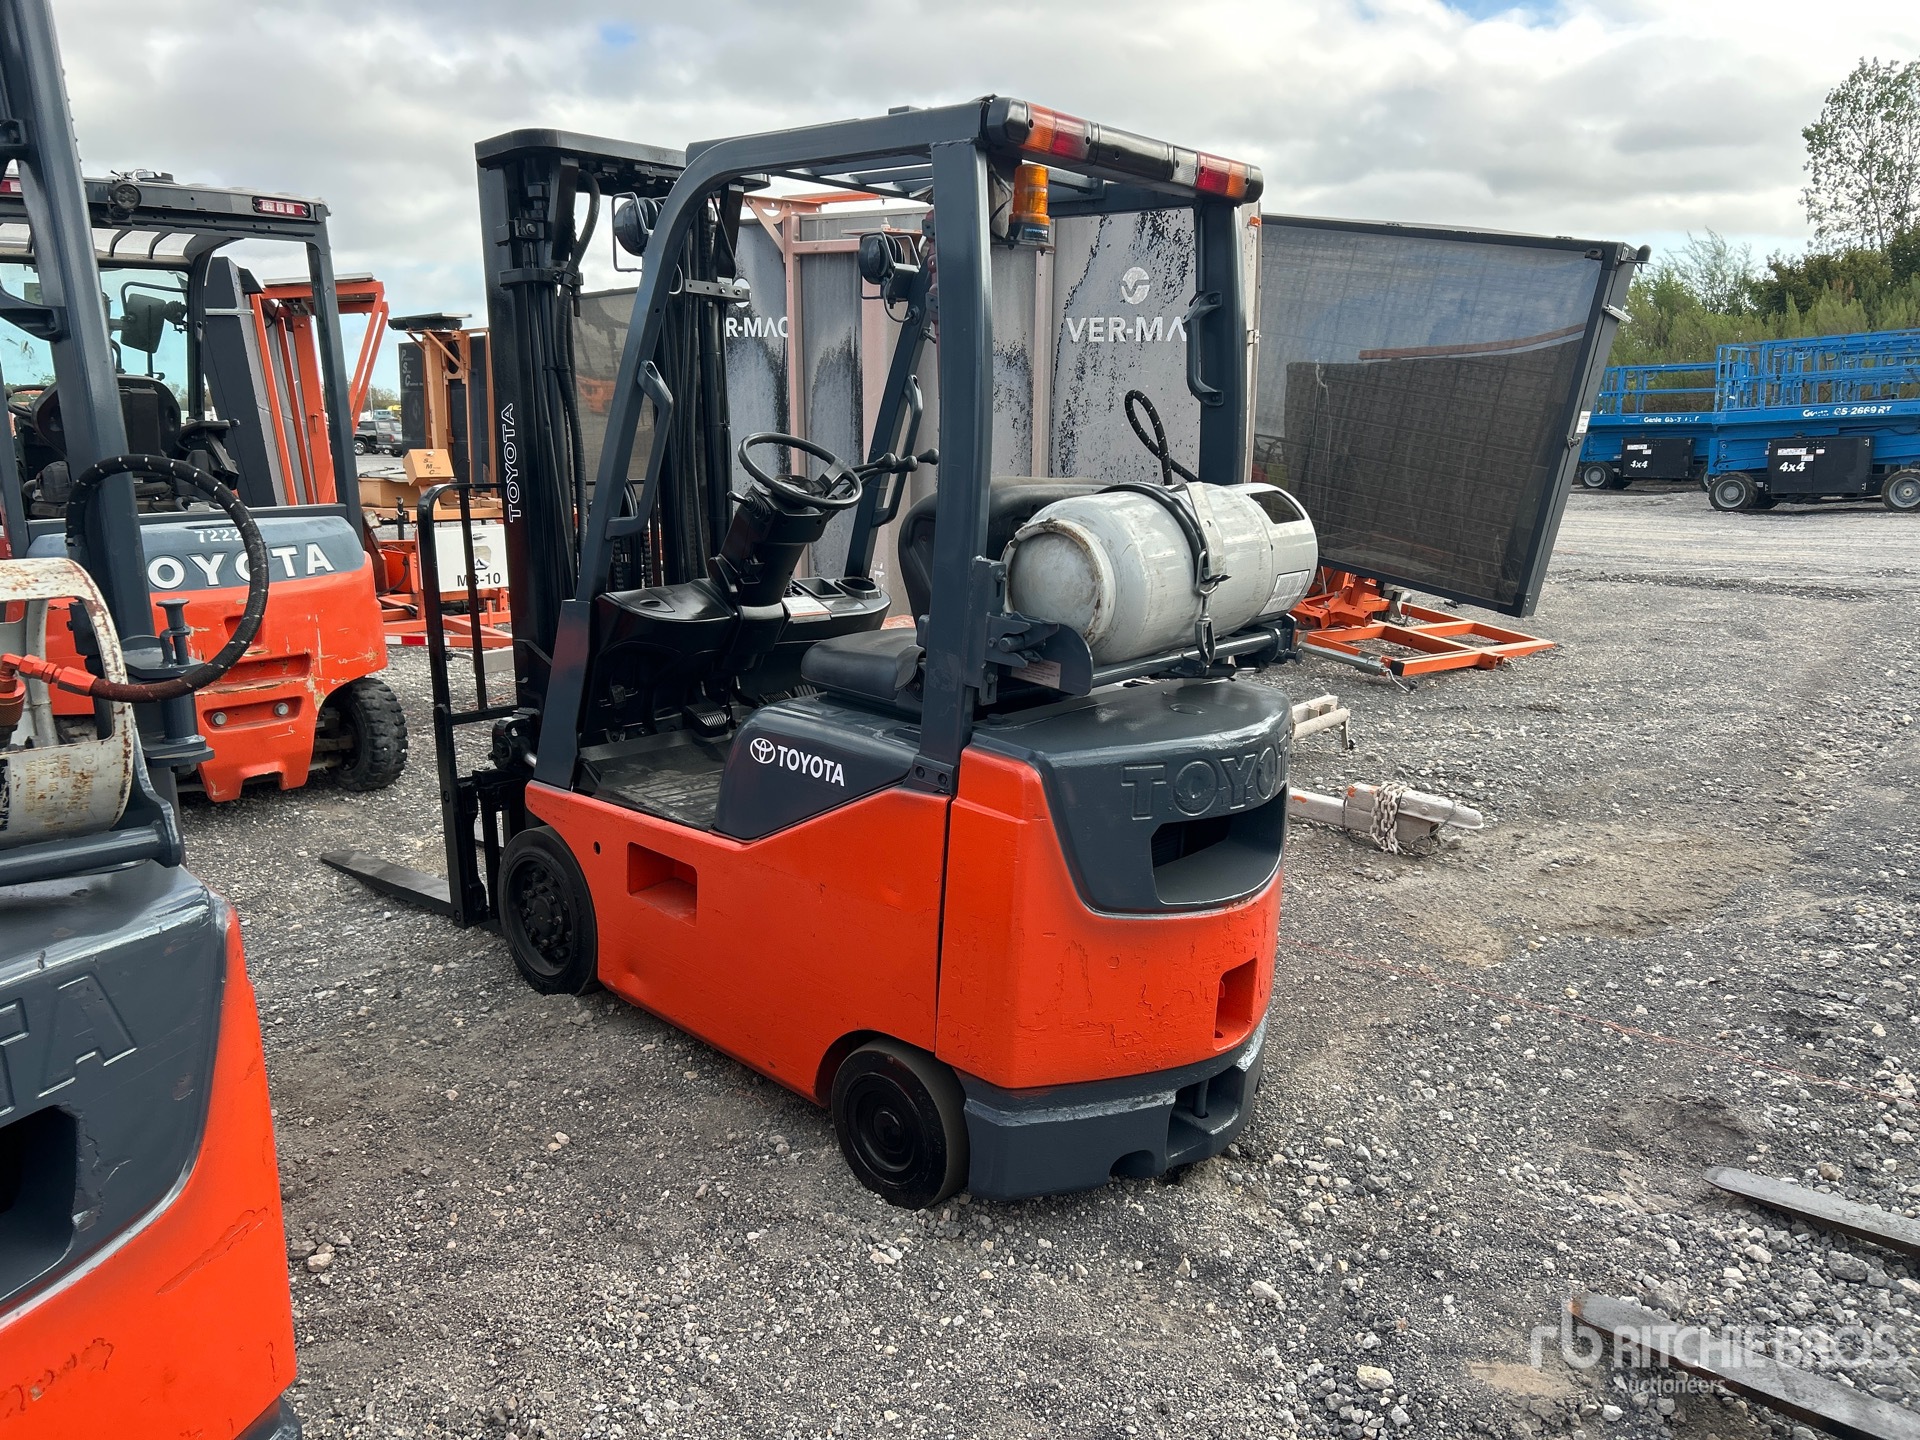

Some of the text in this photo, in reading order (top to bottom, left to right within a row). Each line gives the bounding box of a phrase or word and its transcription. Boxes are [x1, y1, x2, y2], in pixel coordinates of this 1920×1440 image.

[1066, 316, 1188, 342] VER-MA
[501, 403, 521, 522] TOYOTA
[1779, 462, 1806, 472] 4x4
[147, 542, 336, 590] OYOTA
[777, 744, 845, 787] TOYOTA
[1121, 733, 1290, 821] TOYOT
